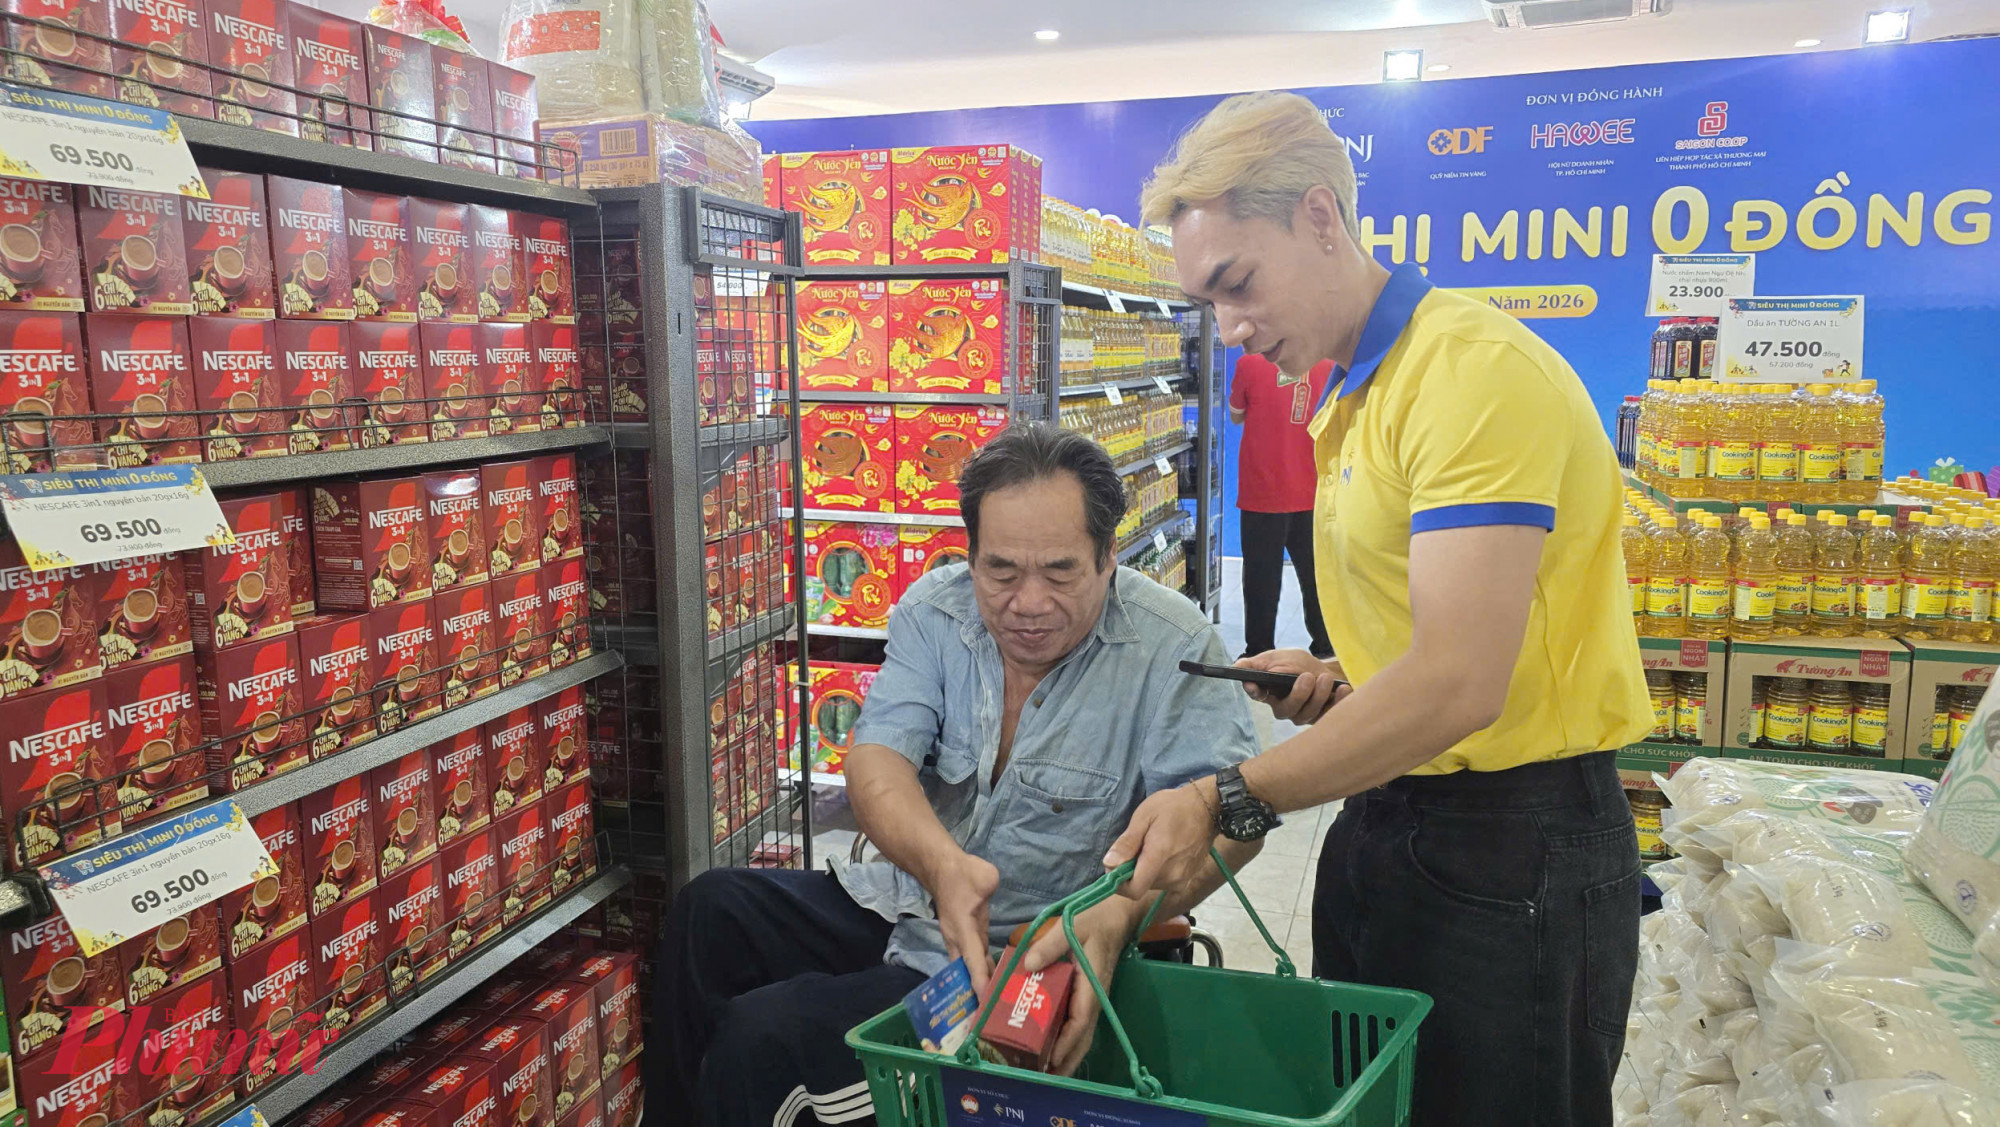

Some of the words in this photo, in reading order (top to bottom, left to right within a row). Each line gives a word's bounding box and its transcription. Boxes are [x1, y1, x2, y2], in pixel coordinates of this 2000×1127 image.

[1526, 94, 1557, 105] ĐƠN
[1578, 87, 1619, 103] ĐỒNG
[1623, 86, 1663, 99] HÀNH
[1318, 107, 1345, 119] HỨC
[1531, 118, 1636, 149] HAWEE
[1675, 139, 1715, 150] SAIGON
[50, 143, 133, 172] 69.500
[1340, 134, 1374, 163] NJ
[1361, 213, 1431, 277] HỊ
[1461, 205, 1628, 262] MINI
[1652, 186, 1710, 255] 0
[1724, 171, 1993, 252] ĐỒNG
[1488, 293, 1531, 310] Năm
[1538, 293, 1584, 309] 2026
[0, 349, 79, 372] ESCAFE
[1745, 341, 1822, 357] 47.500
[101, 475, 129, 487] MINI
[130, 473, 139, 485] 0
[34, 500, 80, 512] NESCAFE
[103, 496, 135, 508] nguyên
[152, 491, 190, 503] 20gx16g
[80, 517, 162, 543] 69.500
[93, 848, 123, 868] SIÊU
[147, 829, 175, 848] MINI
[174, 824, 184, 836] 0
[87, 871, 129, 894] NESCAFE
[150, 851, 181, 873] nguyên
[197, 831, 232, 850] 20gx16g
[131, 868, 209, 914] 69.500
[210, 870, 228, 883] đồng
